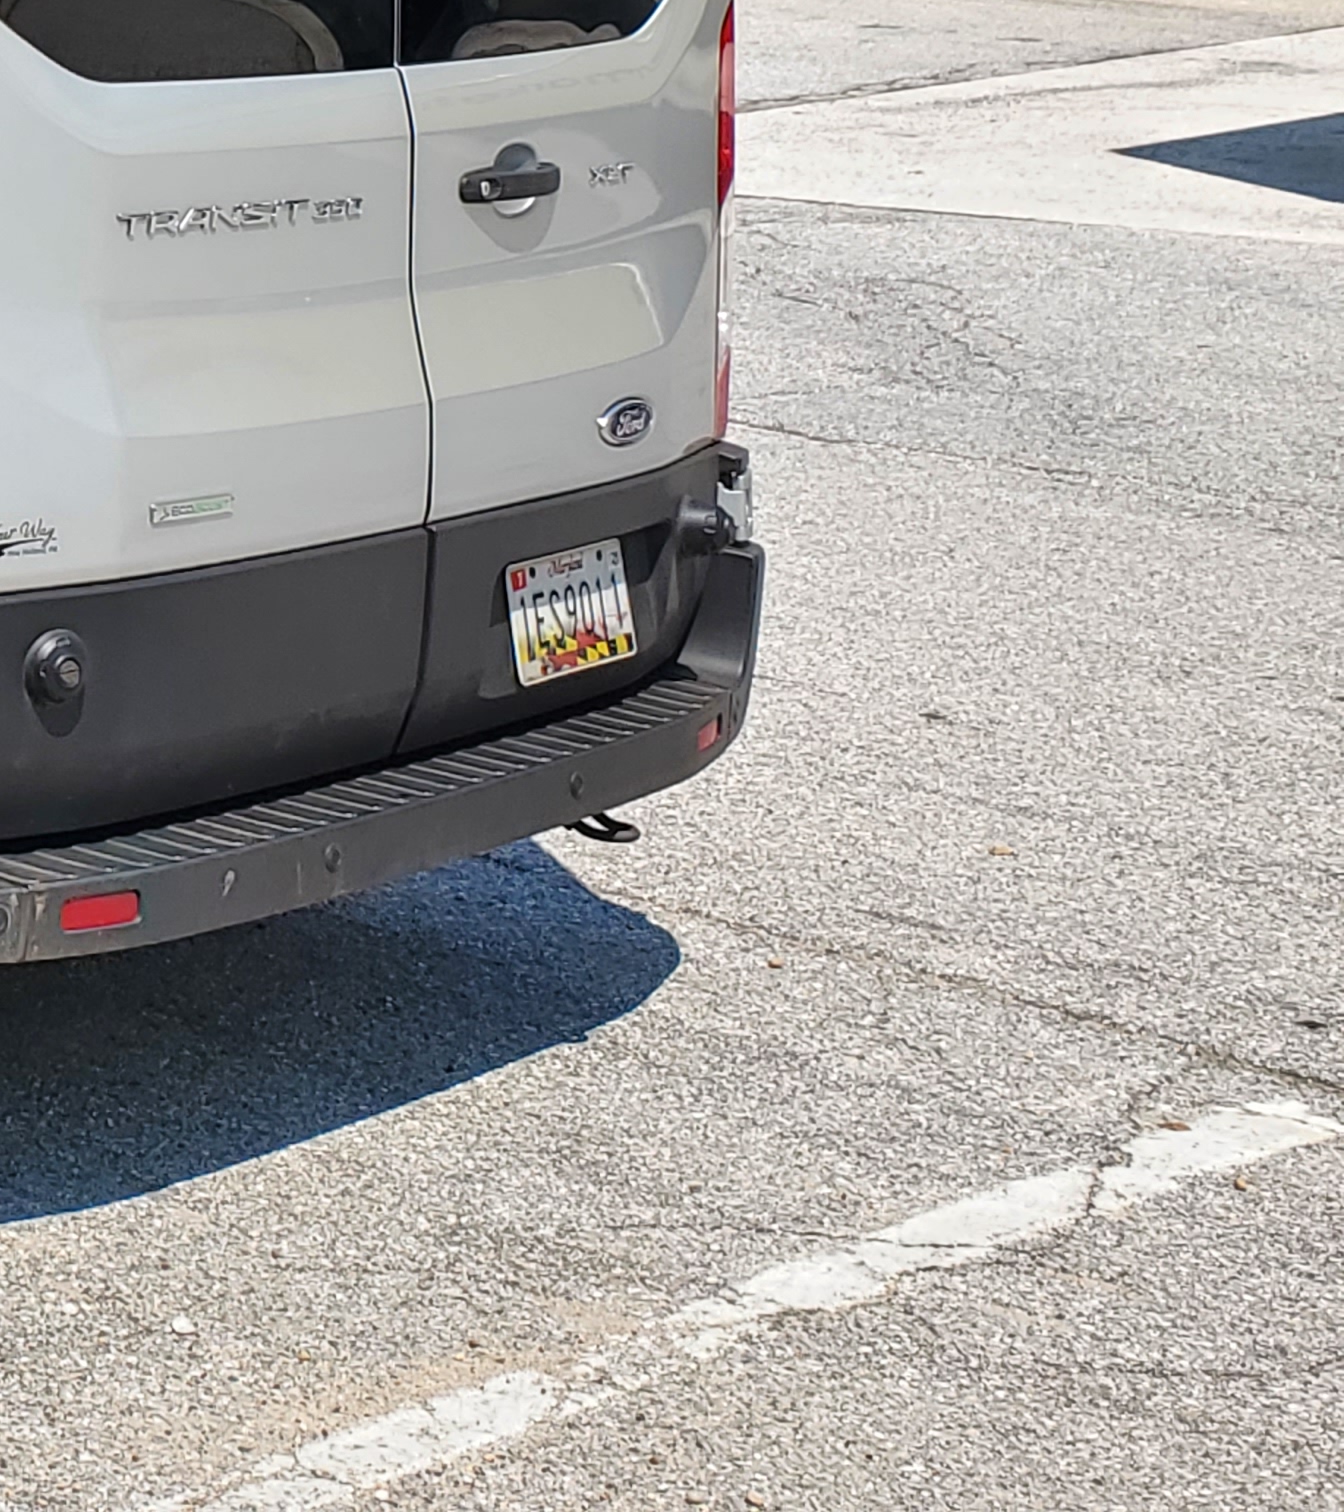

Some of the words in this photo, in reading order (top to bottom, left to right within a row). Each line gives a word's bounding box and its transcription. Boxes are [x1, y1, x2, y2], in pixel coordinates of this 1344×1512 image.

[116, 199, 310, 240] TRANSIT
[616, 408, 647, 437] Ford
[519, 572, 624, 662] 1ES9011
